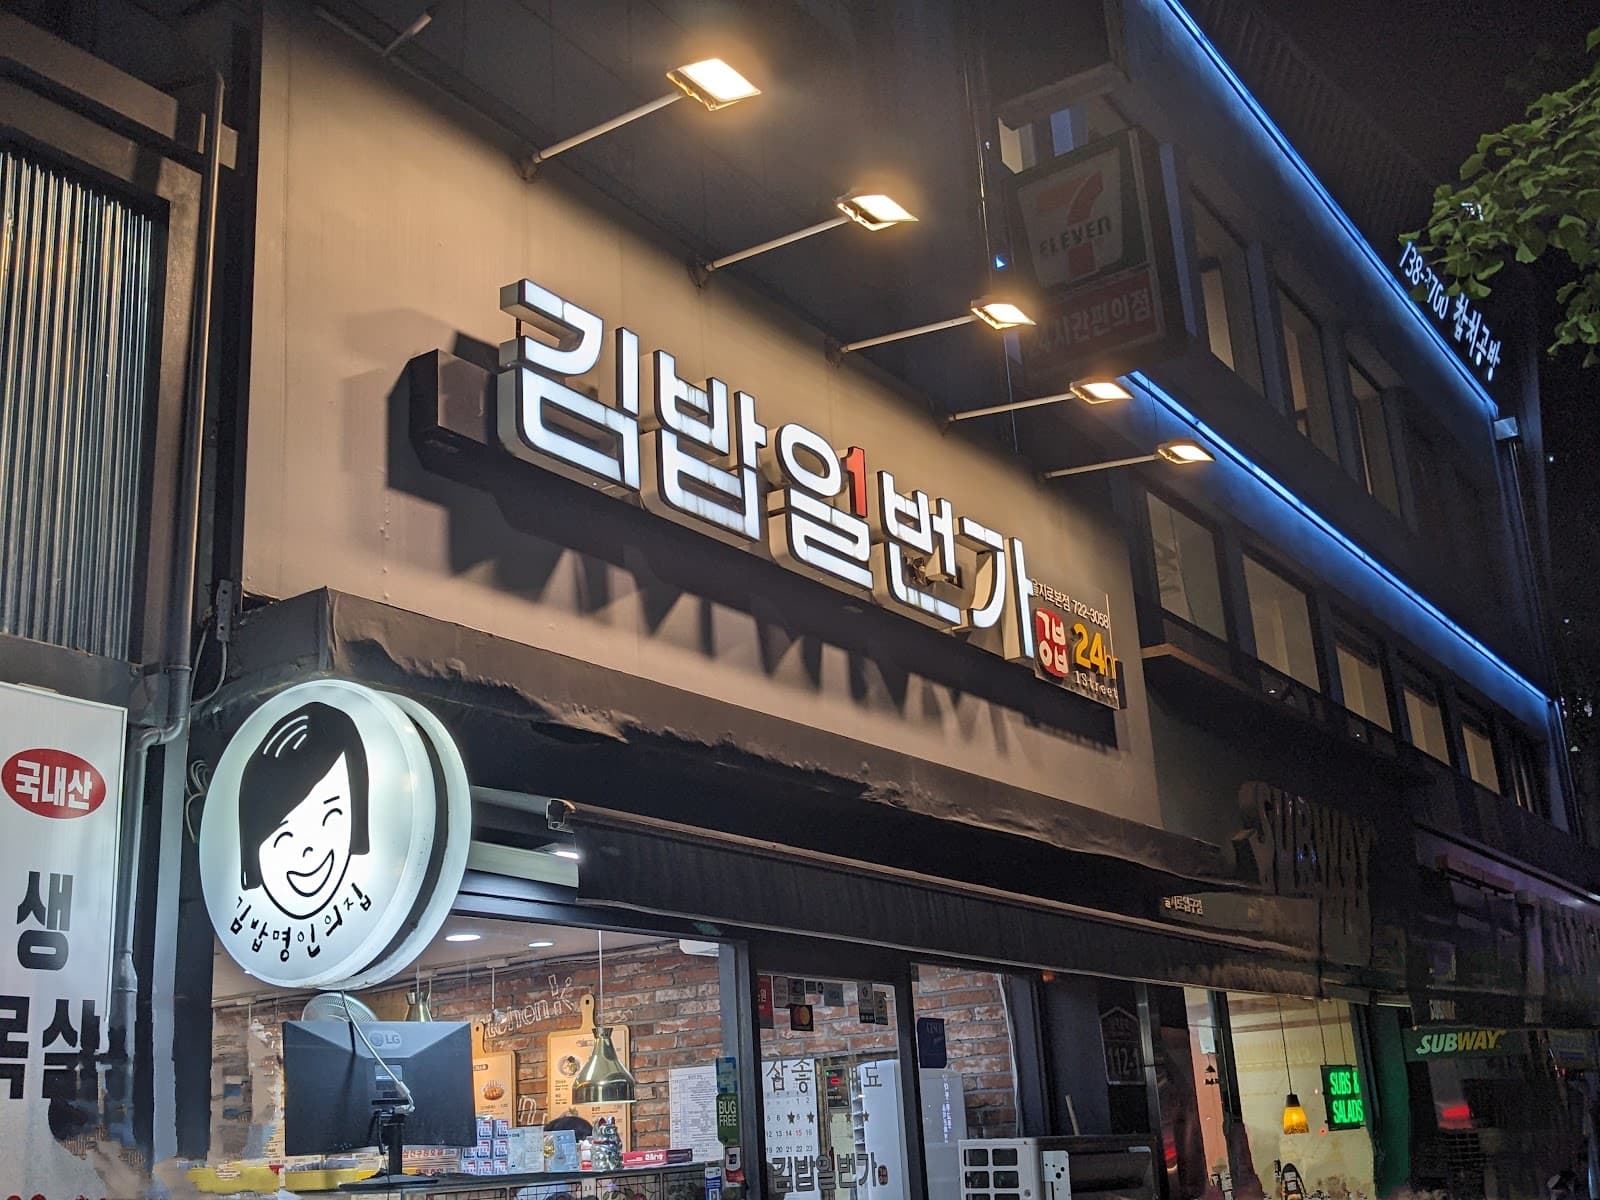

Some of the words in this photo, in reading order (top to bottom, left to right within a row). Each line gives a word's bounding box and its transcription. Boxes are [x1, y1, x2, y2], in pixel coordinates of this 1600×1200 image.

[15, 758, 93, 811] 국내산
[16, 870, 74, 971] 생
[385, 1033, 401, 1045] LG
[1416, 1029, 1506, 1055] SUBWAY
[1330, 1072, 1352, 1095] SUBS
[718, 1100, 737, 1115] BUG
[1332, 1099, 1364, 1124] SALADS
[719, 1114, 737, 1127] FREE
